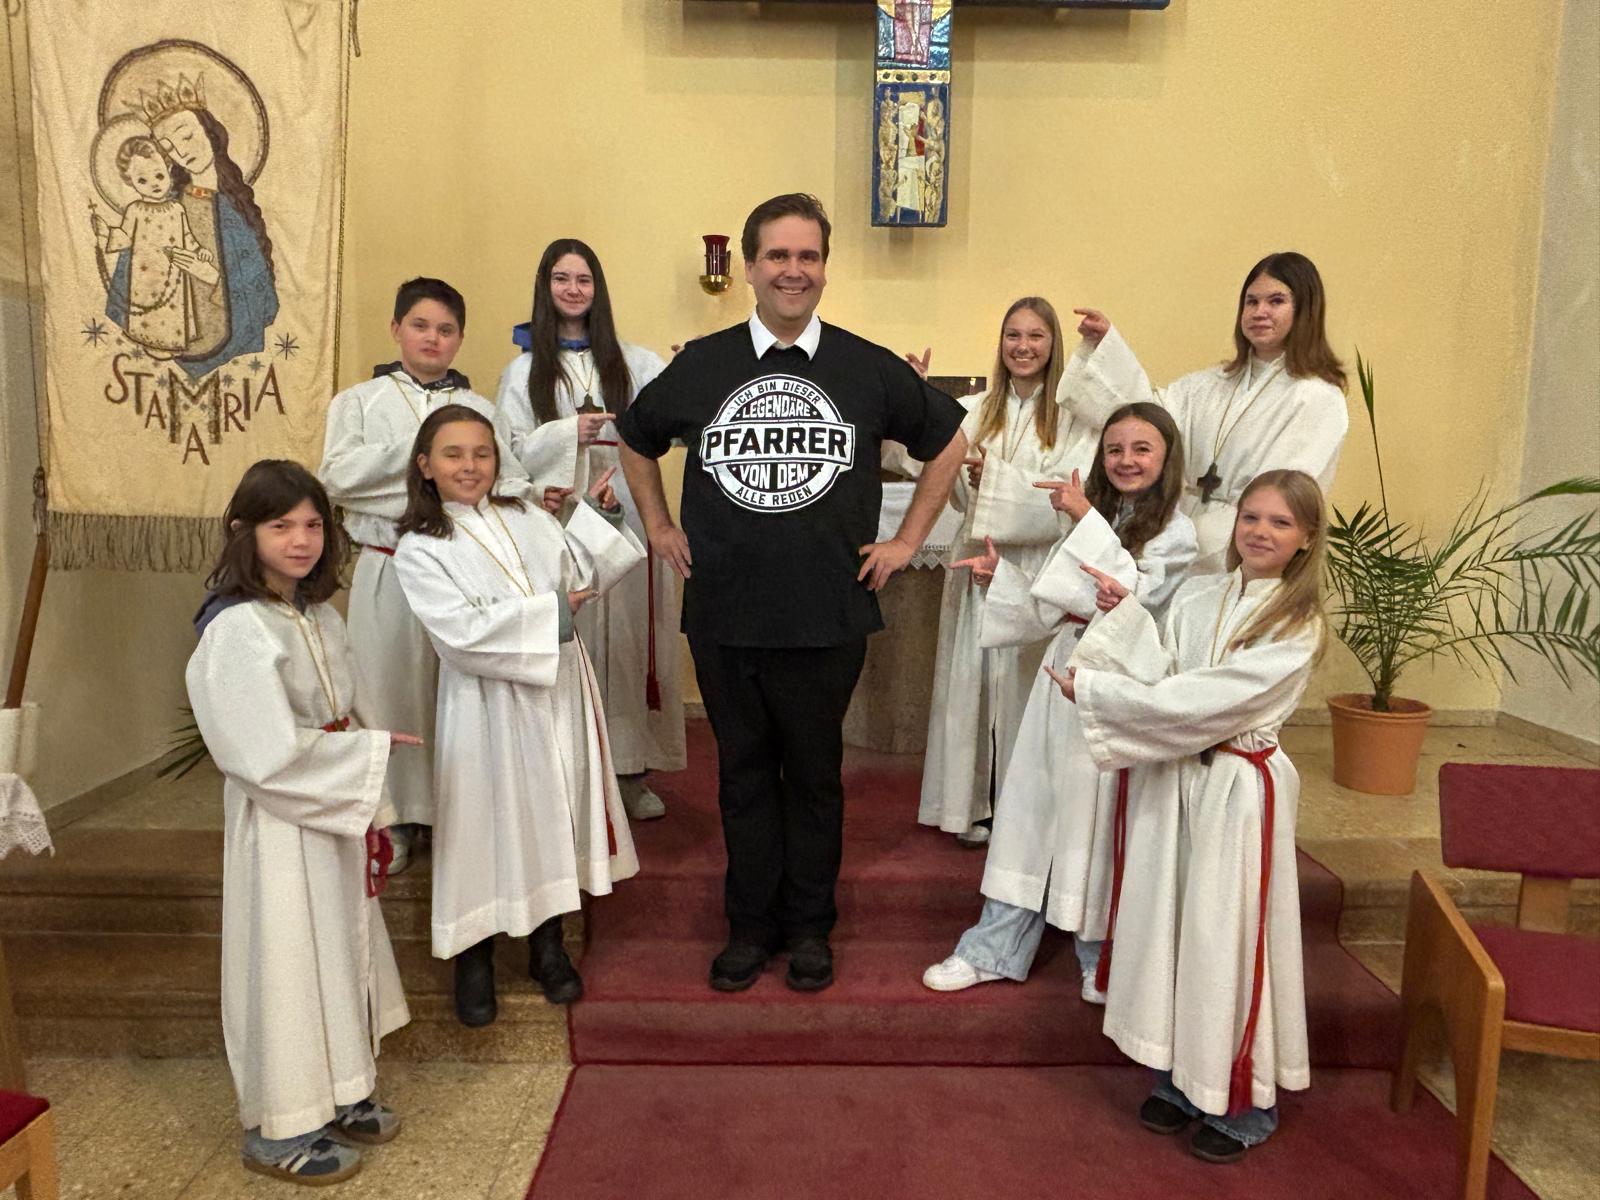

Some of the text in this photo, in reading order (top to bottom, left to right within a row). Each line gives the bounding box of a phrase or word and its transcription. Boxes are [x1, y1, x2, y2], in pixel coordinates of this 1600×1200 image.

[735, 381, 821, 407] ICH BIN DIESER
[742, 394, 811, 418] LEGENDÄRE
[705, 427, 847, 460] PFARRER
[739, 464, 809, 490] VON DEM
[735, 485, 813, 506] ALLE REDEN
